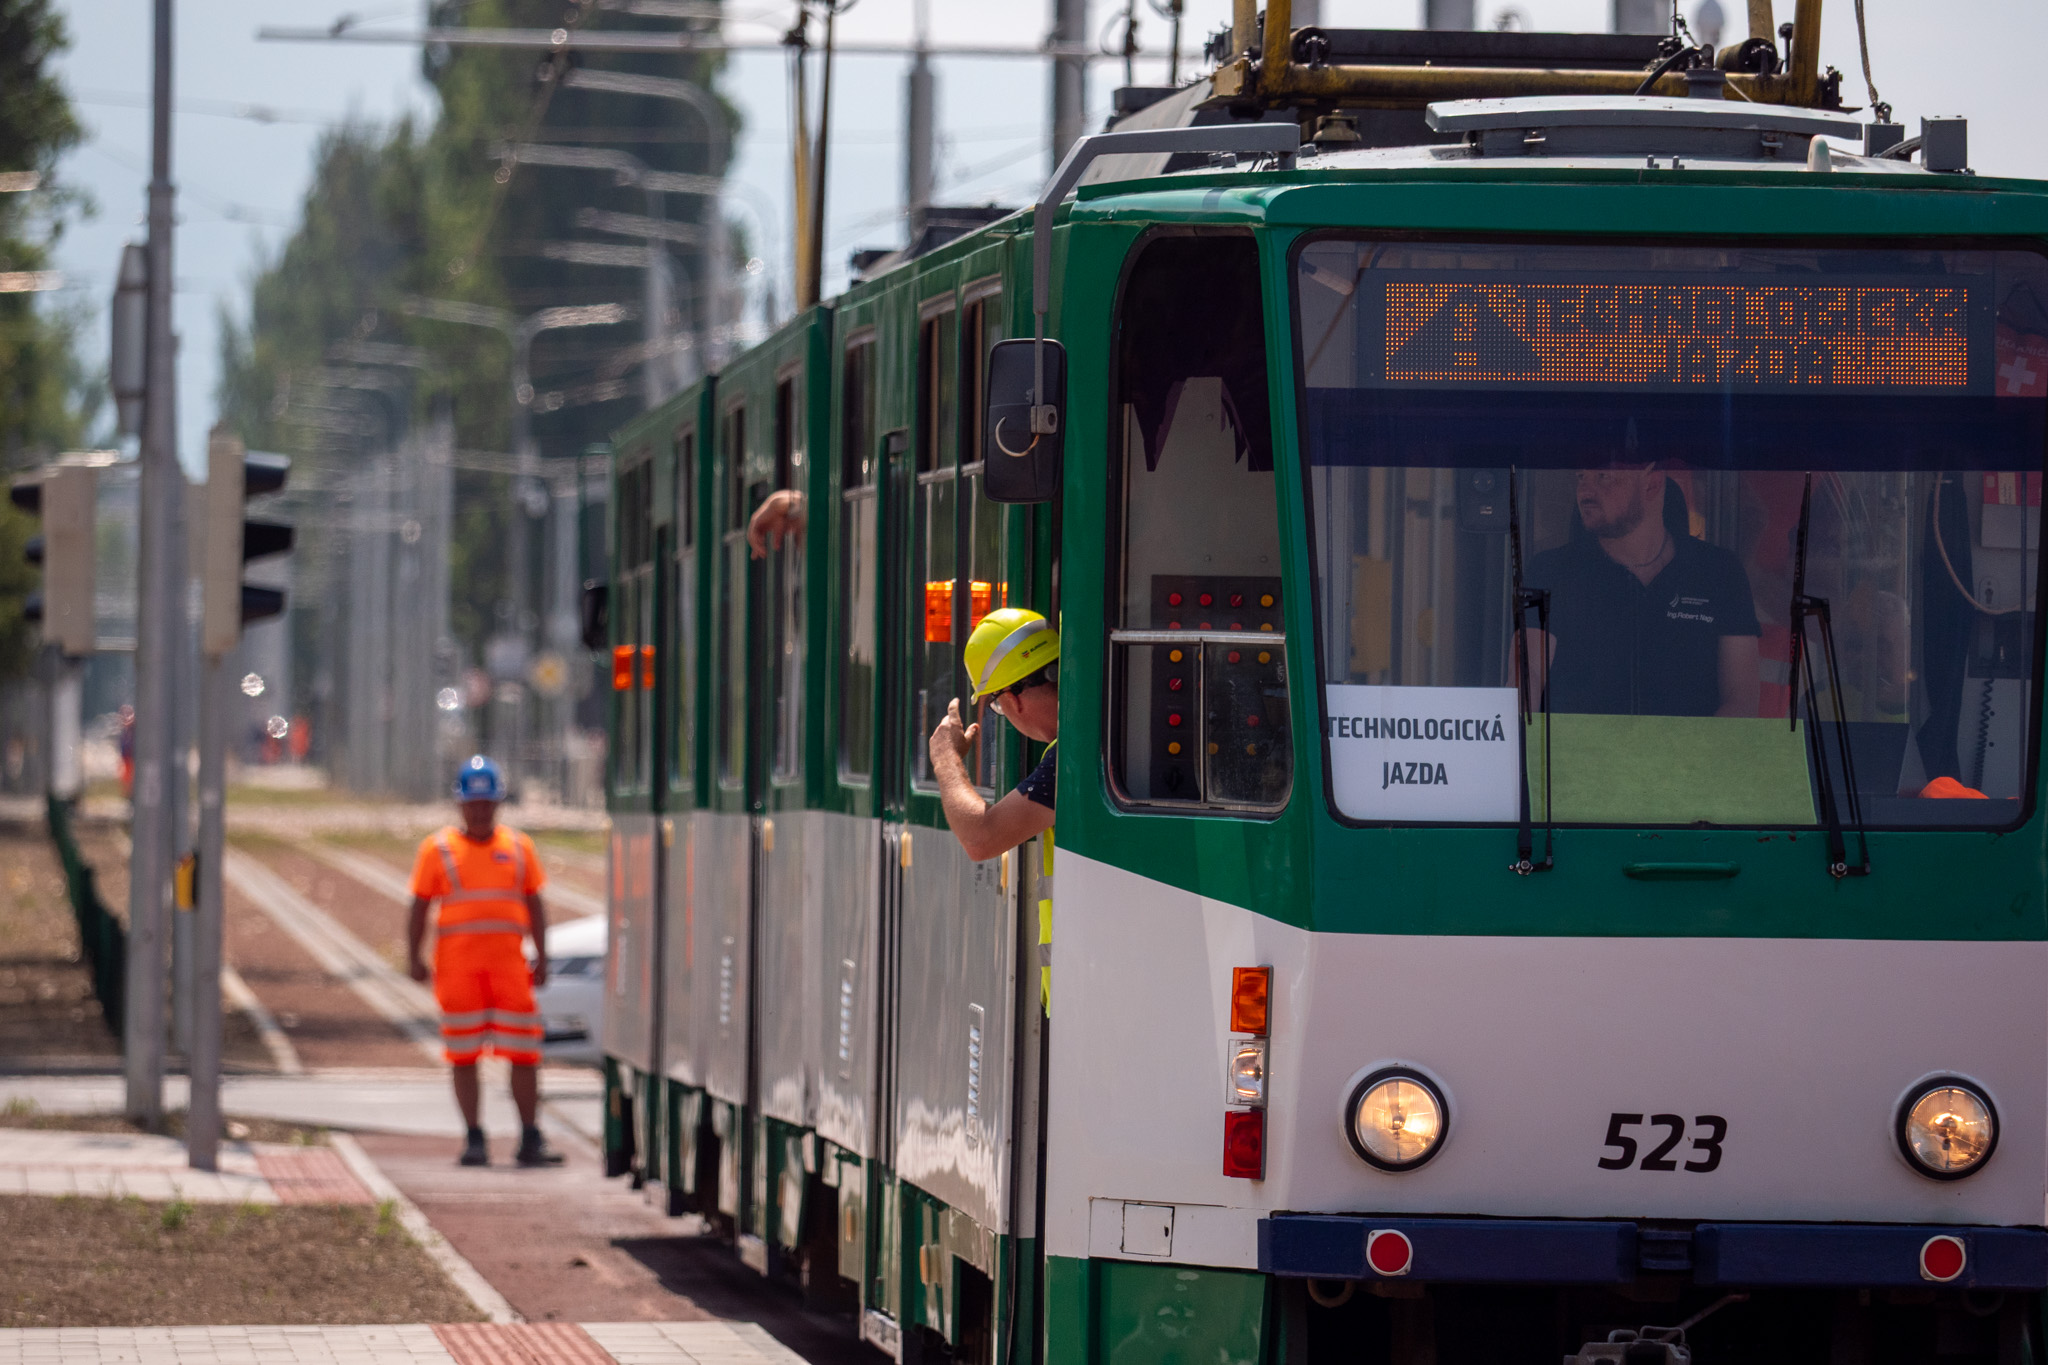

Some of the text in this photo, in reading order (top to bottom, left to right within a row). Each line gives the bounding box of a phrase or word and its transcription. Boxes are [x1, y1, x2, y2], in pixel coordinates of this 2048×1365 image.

[1328, 713, 1505, 741] TECHNOLOGICKÁ
[1382, 761, 1448, 790] JAZDA
[1598, 1113, 1727, 1173] 523
